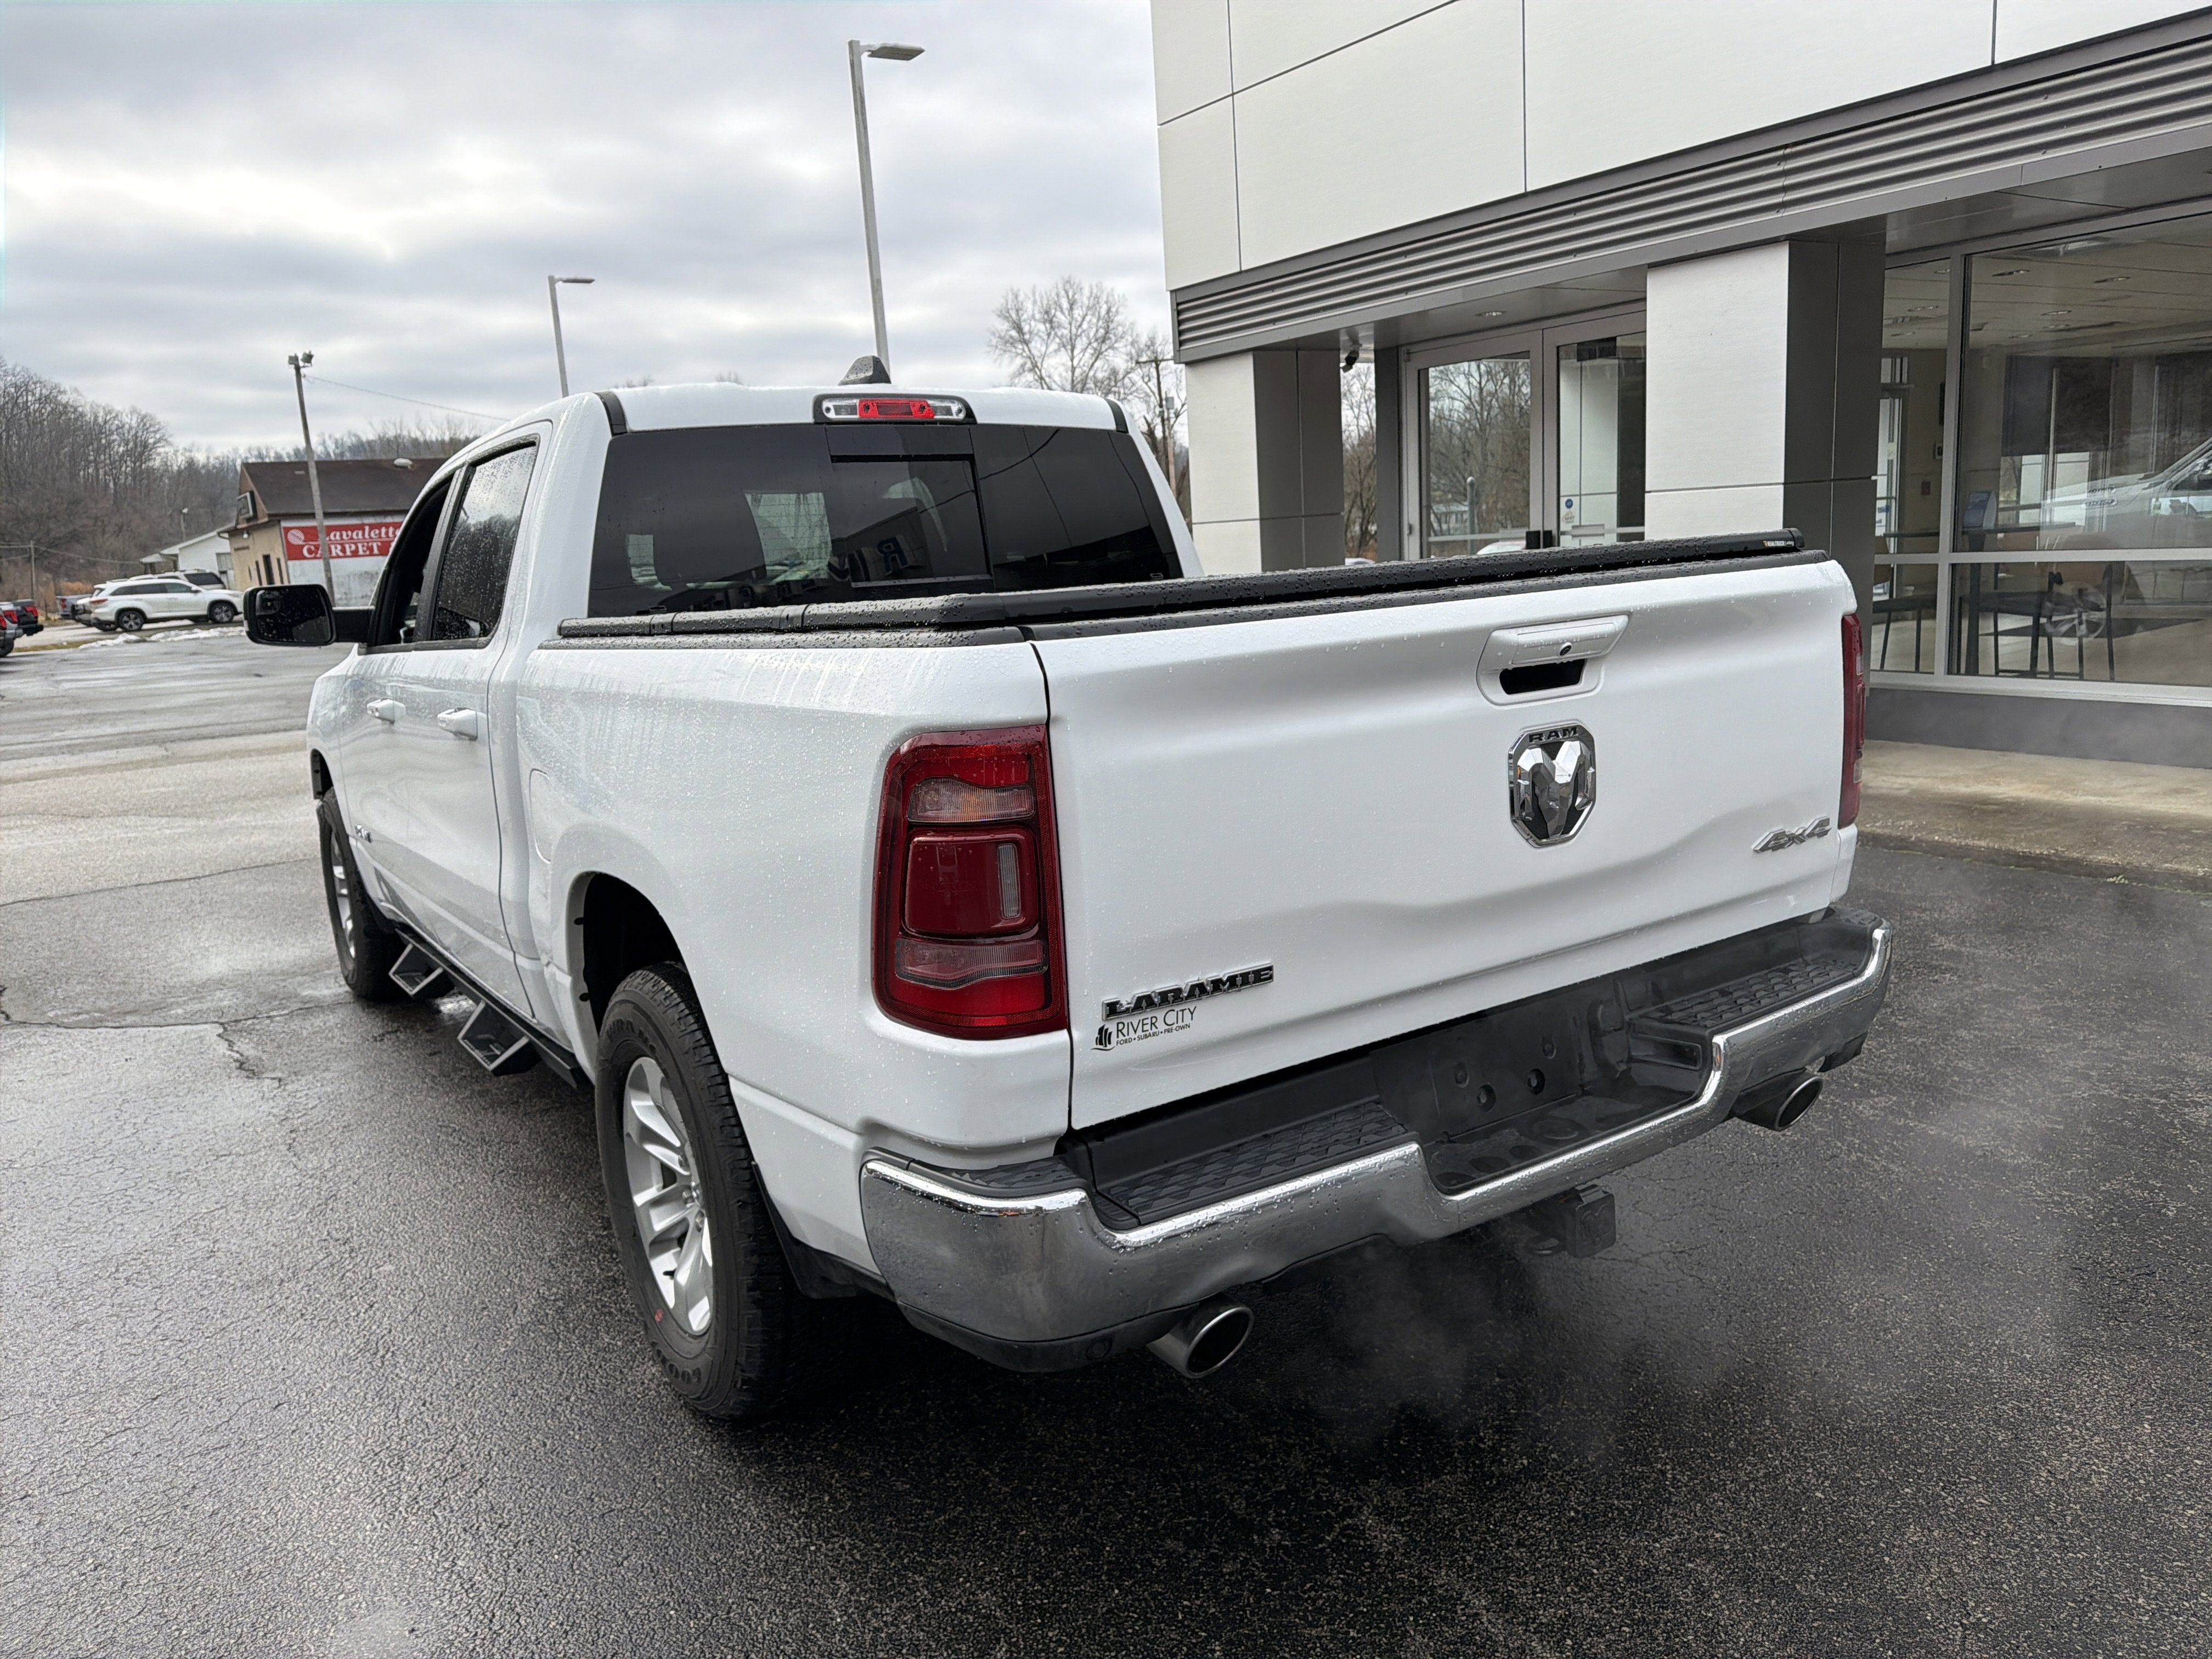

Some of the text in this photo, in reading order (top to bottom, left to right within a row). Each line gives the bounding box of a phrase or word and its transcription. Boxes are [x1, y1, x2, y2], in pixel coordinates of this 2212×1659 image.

[318, 525, 401, 541] avalett
[1528, 726, 1579, 742] RAM
[1102, 962, 1274, 1021] LARAMIE
[1116, 1006, 1197, 1039] RIVER CITY
[1116, 1023, 1190, 1046] FORD SUBARU PRE-OWN
